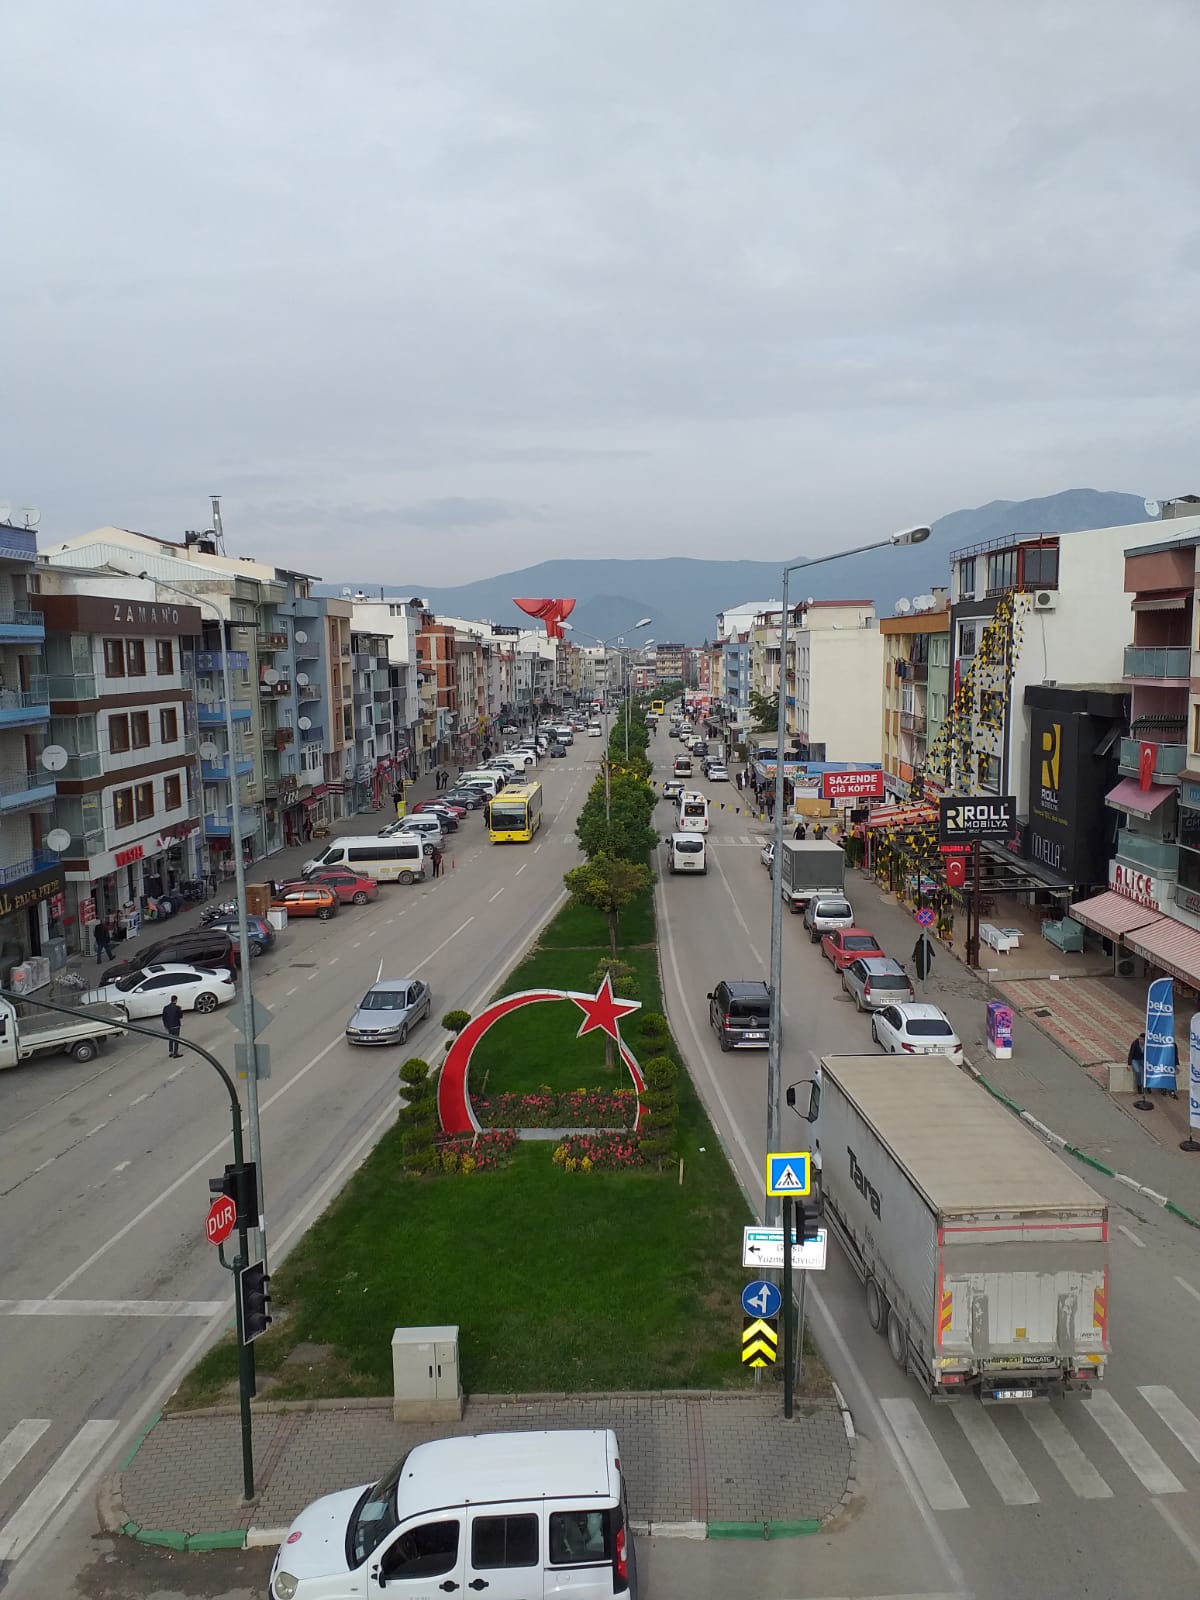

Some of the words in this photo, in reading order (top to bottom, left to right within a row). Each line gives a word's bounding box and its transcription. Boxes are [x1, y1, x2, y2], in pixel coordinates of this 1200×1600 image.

[828, 774, 878, 785] SAZENDE
[964, 805, 1010, 820] ROLL
[1148, 1000, 1173, 1013] beko
[1147, 1029, 1174, 1044] beko
[1146, 1061, 1175, 1073] beko
[847, 1145, 882, 1222] Tara
[208, 1206, 233, 1236] DUR
